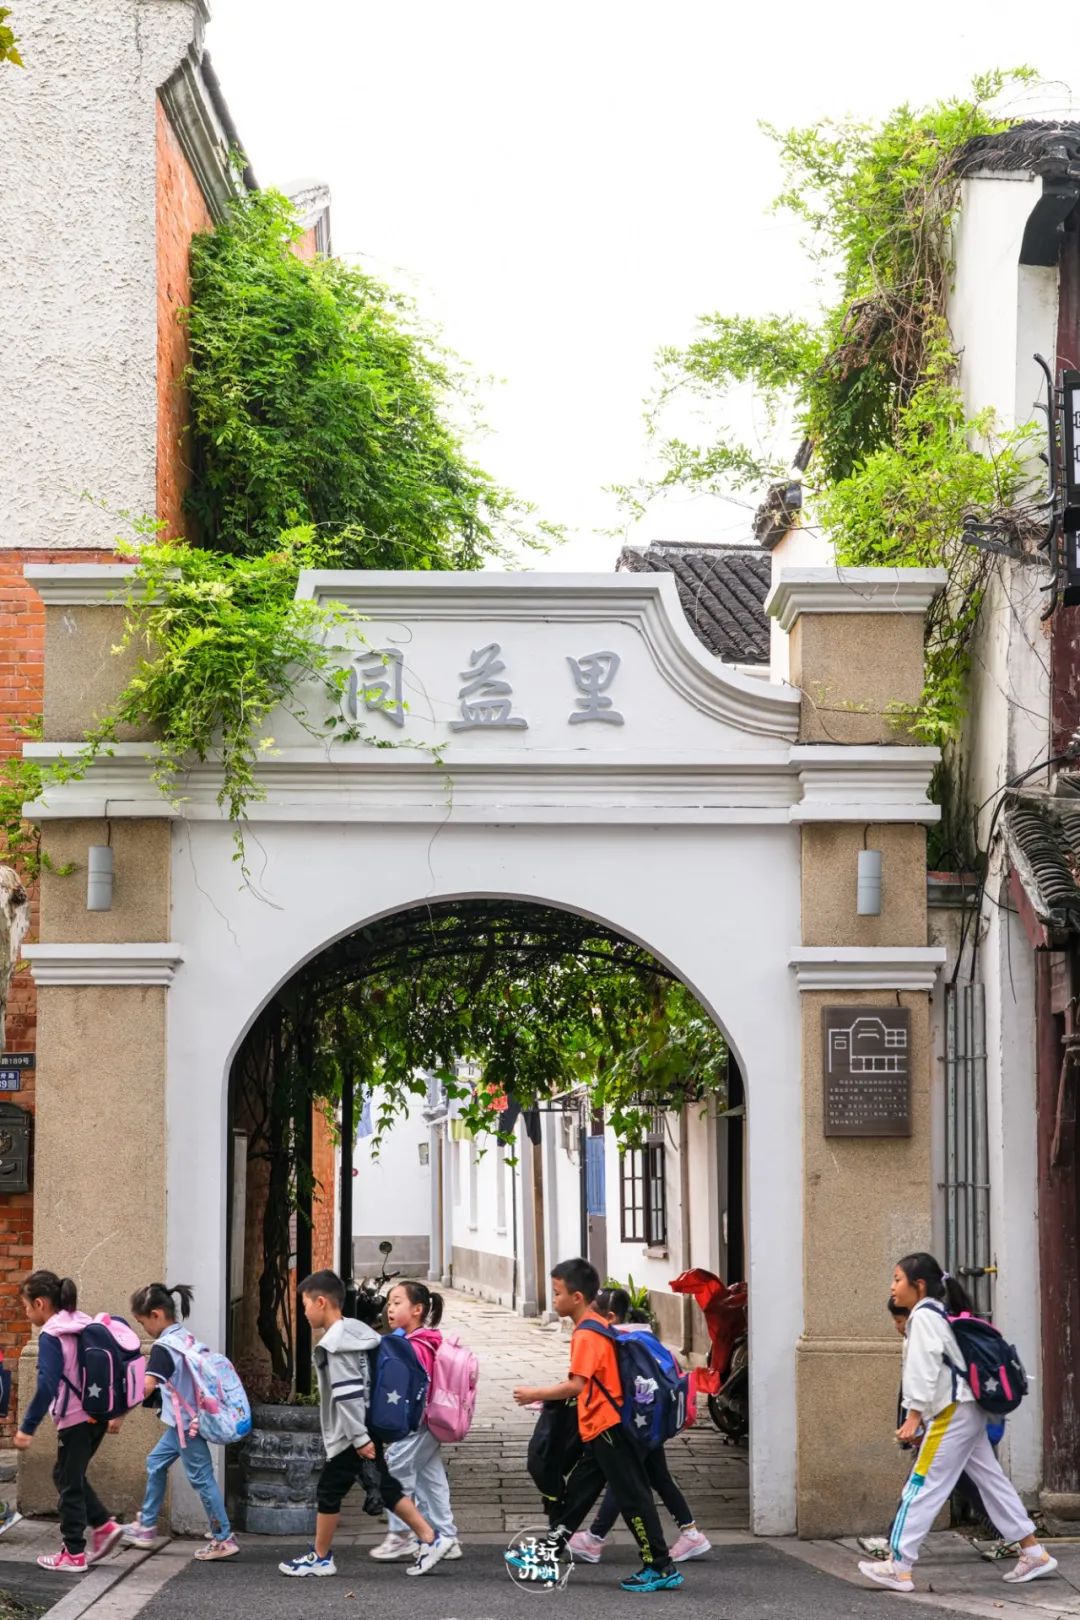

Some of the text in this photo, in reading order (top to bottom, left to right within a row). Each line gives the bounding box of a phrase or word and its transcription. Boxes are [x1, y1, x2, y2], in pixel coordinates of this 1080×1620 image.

[348, 642, 625, 733] 同益里
[0, 1080, 7, 1089] 9
